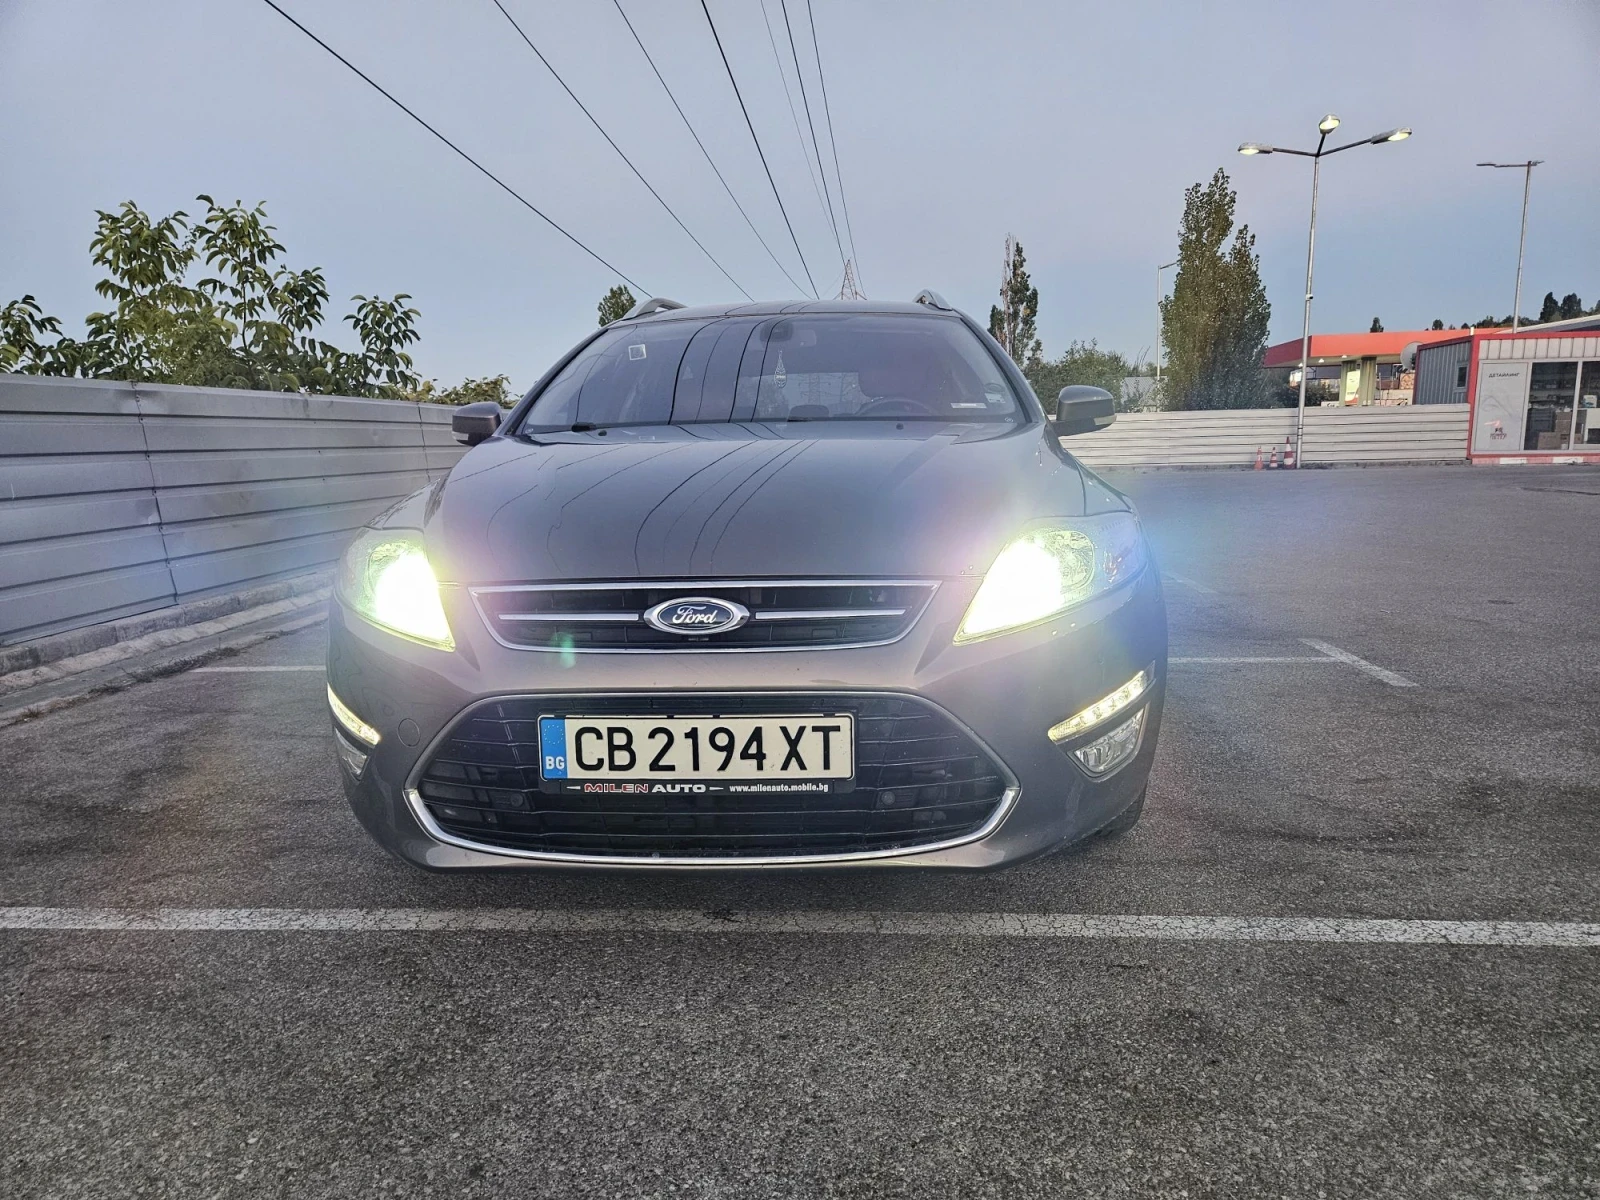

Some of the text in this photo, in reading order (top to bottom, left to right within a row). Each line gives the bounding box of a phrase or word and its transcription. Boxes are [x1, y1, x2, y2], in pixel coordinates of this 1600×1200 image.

[672, 605, 718, 624] Ford
[575, 725, 841, 772] CB 2194 XT
[545, 756, 565, 770] BG
[584, 782, 829, 794] MILEN AUTO www.milenauto.mobile.bg
